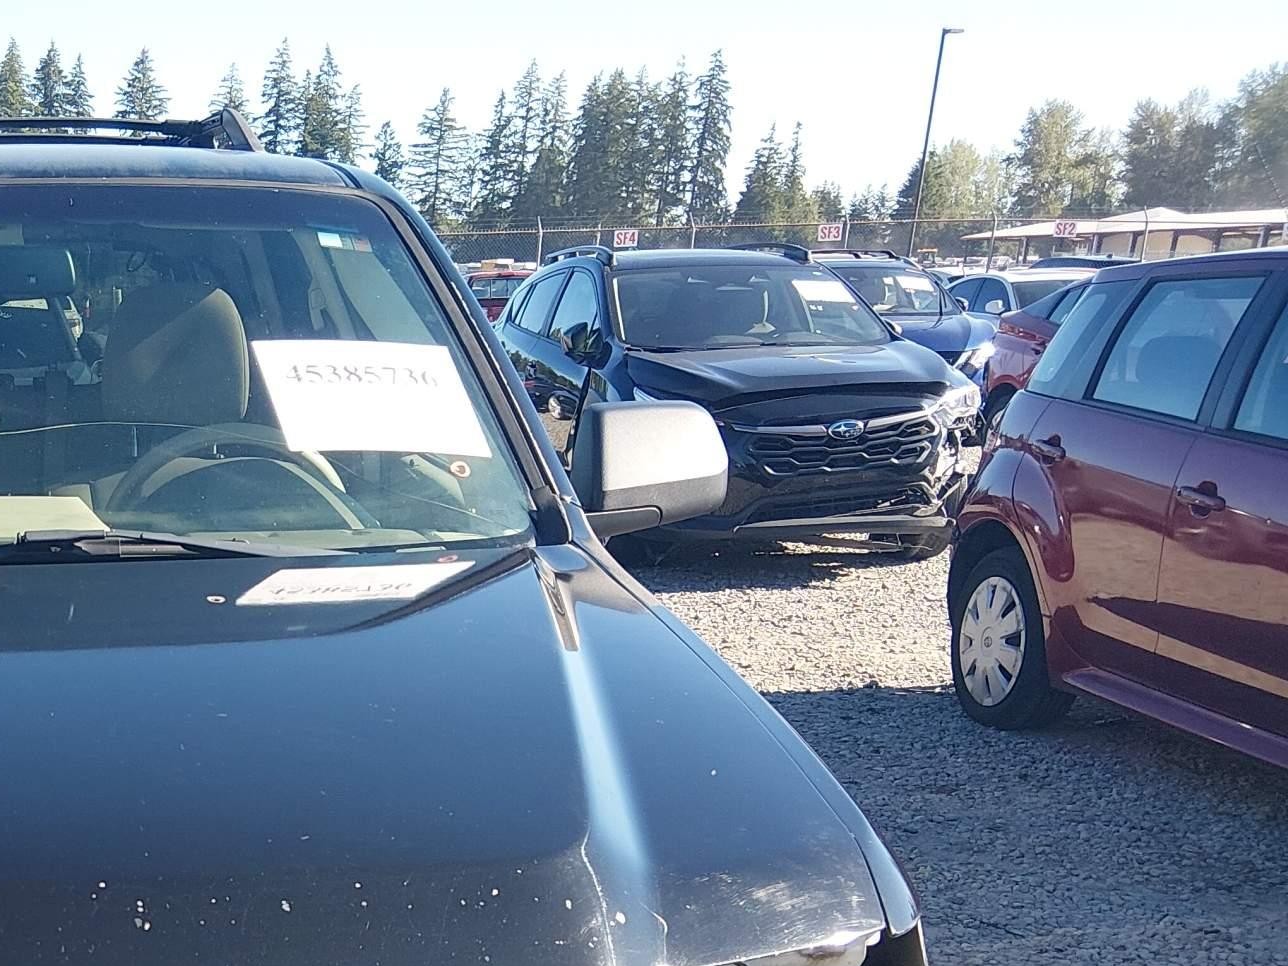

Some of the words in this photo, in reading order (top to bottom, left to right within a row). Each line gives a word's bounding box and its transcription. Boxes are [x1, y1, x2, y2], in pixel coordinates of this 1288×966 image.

[820, 225, 841, 240] SF3
[1055, 222, 1076, 236] SF2
[616, 231, 636, 246] SF4
[285, 364, 439, 387] 45385736
